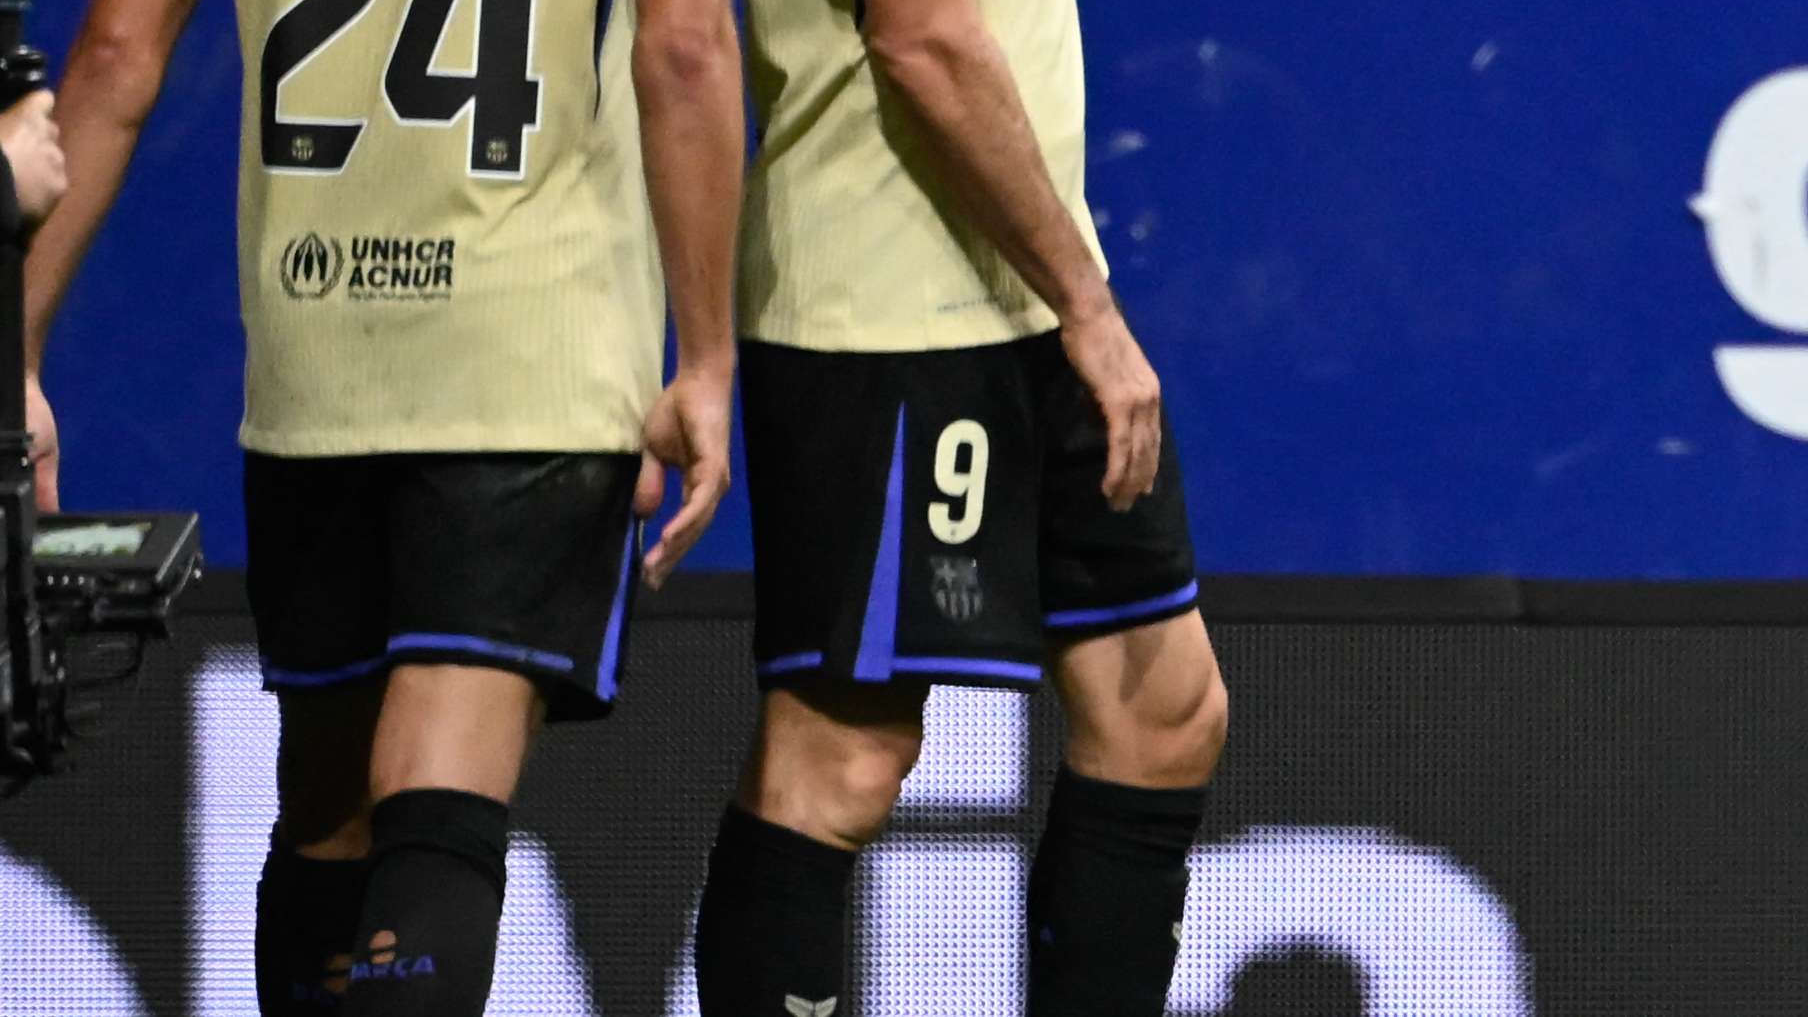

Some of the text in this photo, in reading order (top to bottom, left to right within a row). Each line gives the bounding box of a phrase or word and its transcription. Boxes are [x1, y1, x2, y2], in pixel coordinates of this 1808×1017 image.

[352, 237, 455, 263] UNHCR
[349, 265, 453, 288] ACNUR
[928, 418, 989, 545] 9
